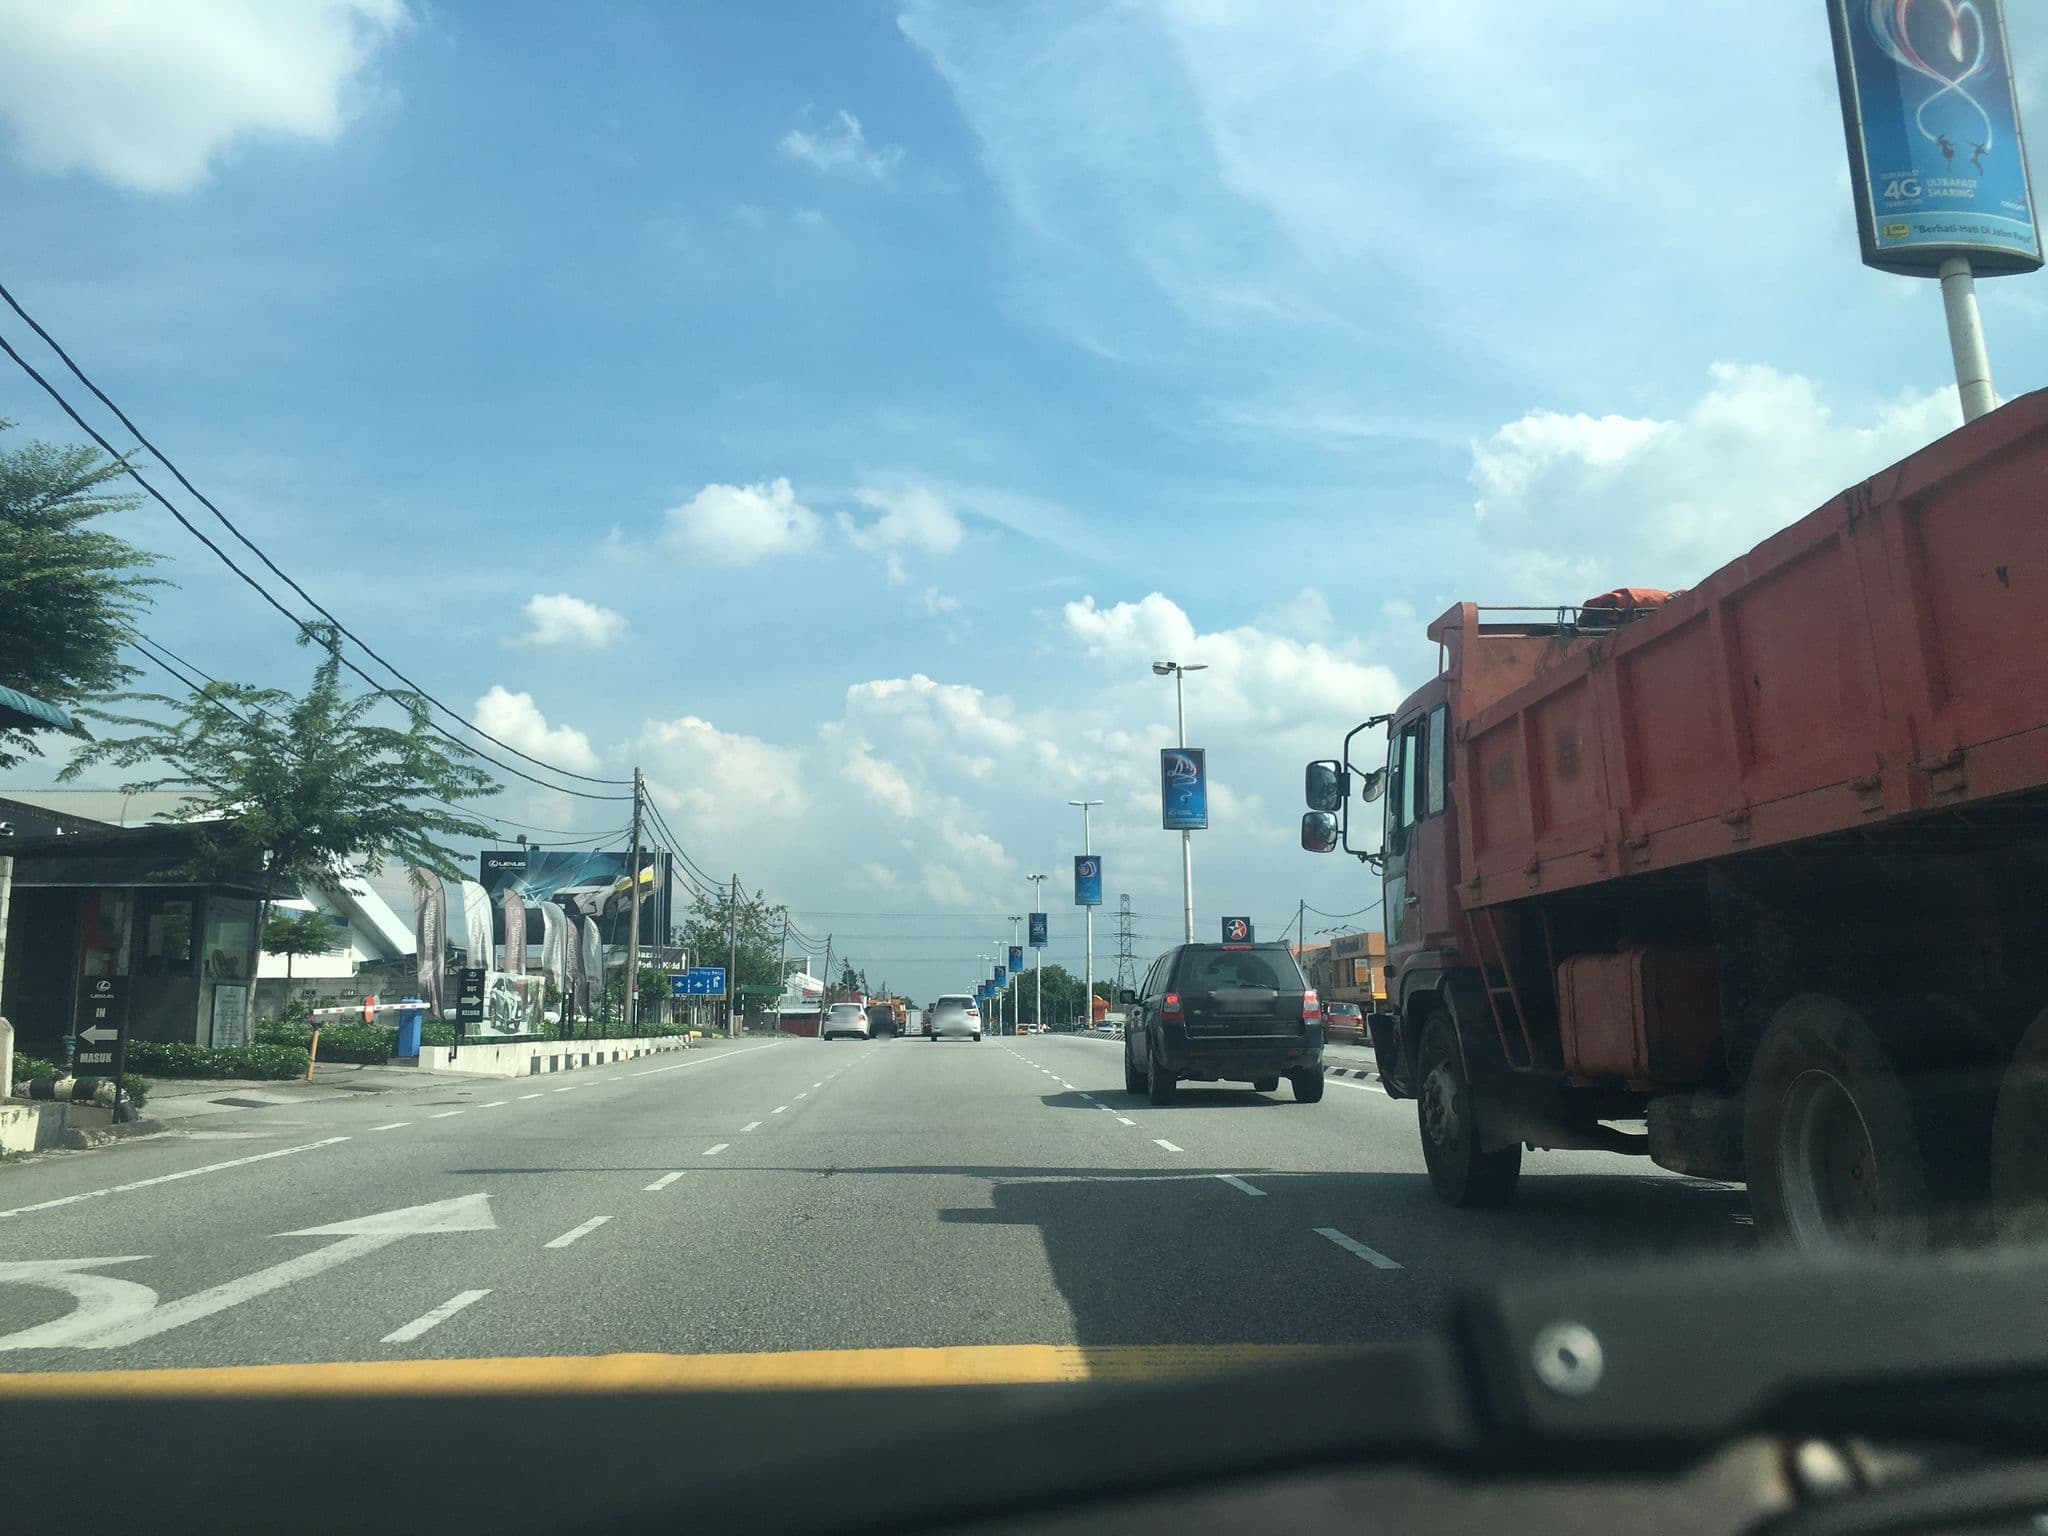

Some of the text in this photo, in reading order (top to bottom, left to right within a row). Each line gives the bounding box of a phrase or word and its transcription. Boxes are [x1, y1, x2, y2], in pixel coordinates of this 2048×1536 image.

[1884, 179, 1921, 199] 4G
[1927, 189, 1974, 198] SHARING
[95, 1007, 106, 1018] IN
[79, 1052, 112, 1064] MASUK
